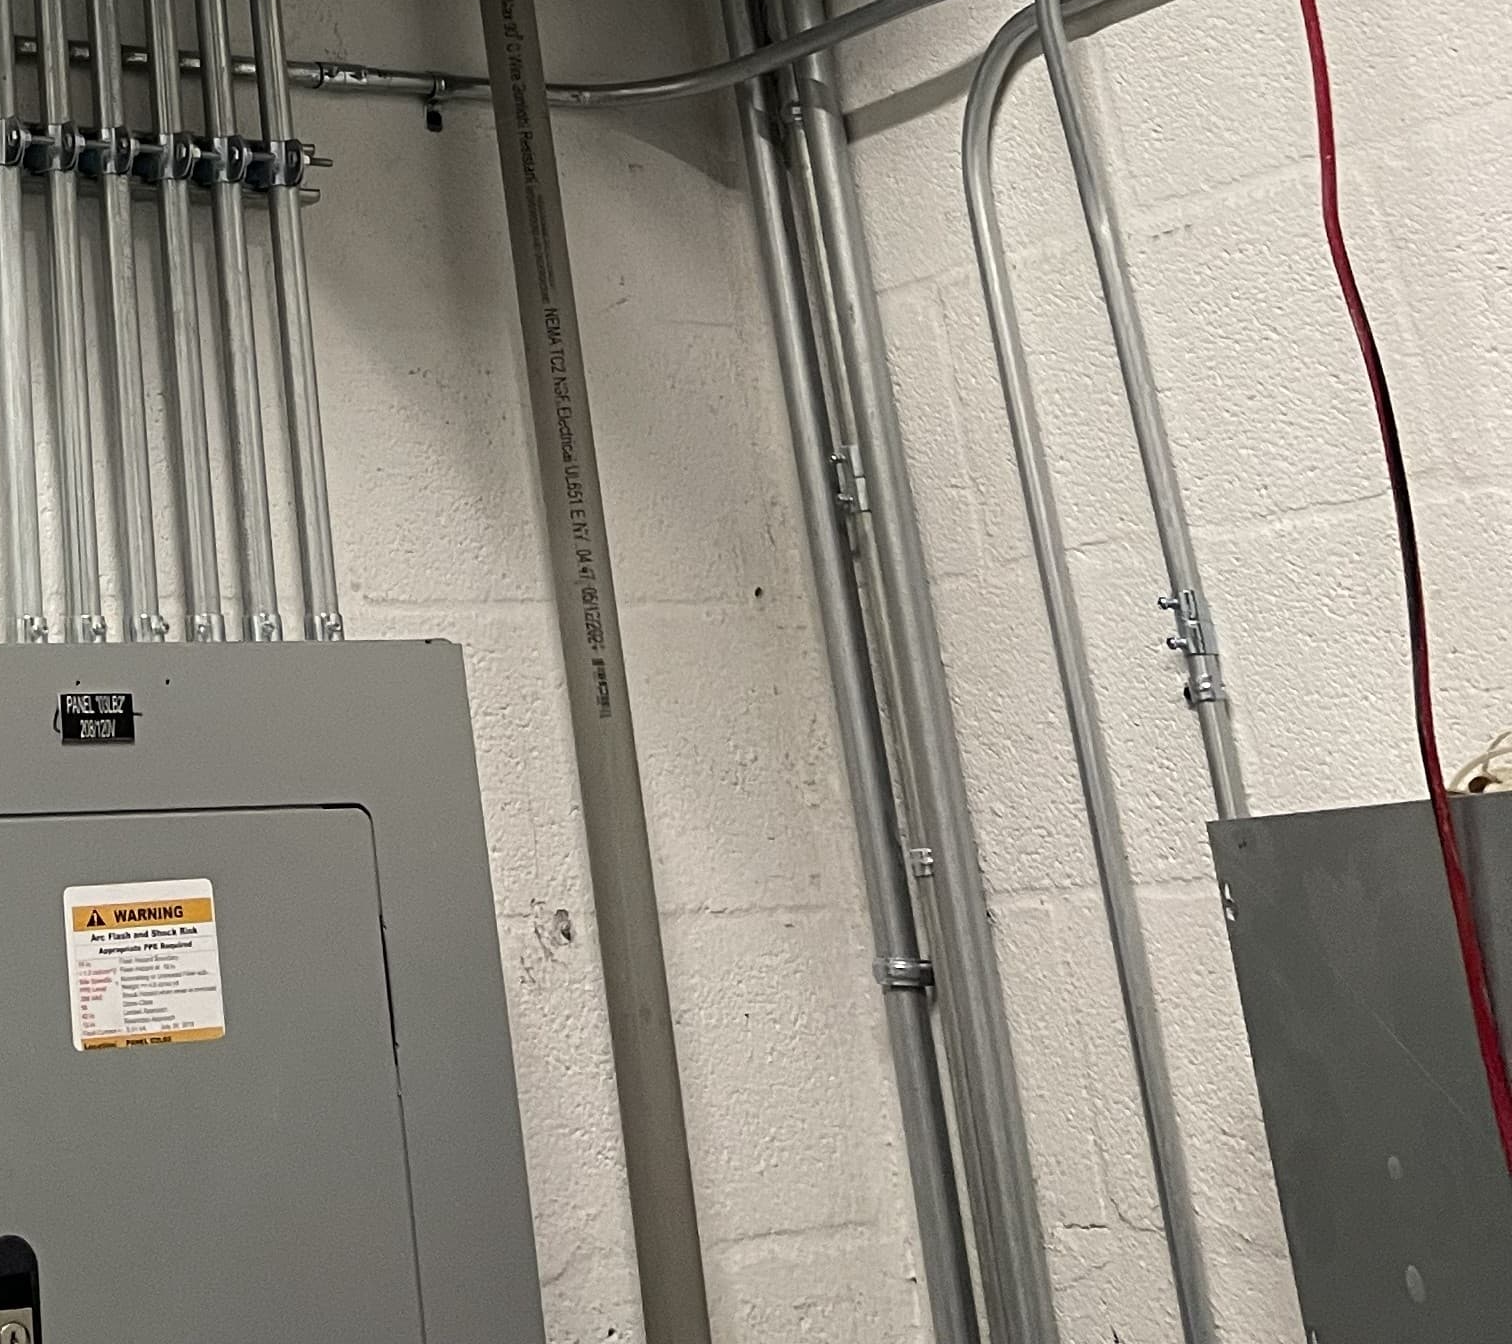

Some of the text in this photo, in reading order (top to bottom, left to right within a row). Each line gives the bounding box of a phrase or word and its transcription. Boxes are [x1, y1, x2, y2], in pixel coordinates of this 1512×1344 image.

[544, 307, 562, 345] NEMA
[548, 348, 566, 374] TC2
[66, 695, 95, 714] PANEL
[114, 906, 184, 923] WARNING
[91, 933, 105, 942] Arc
[108, 932, 131, 941] Flash
[133, 931, 149, 939] and
[151, 929, 177, 938] Shock
